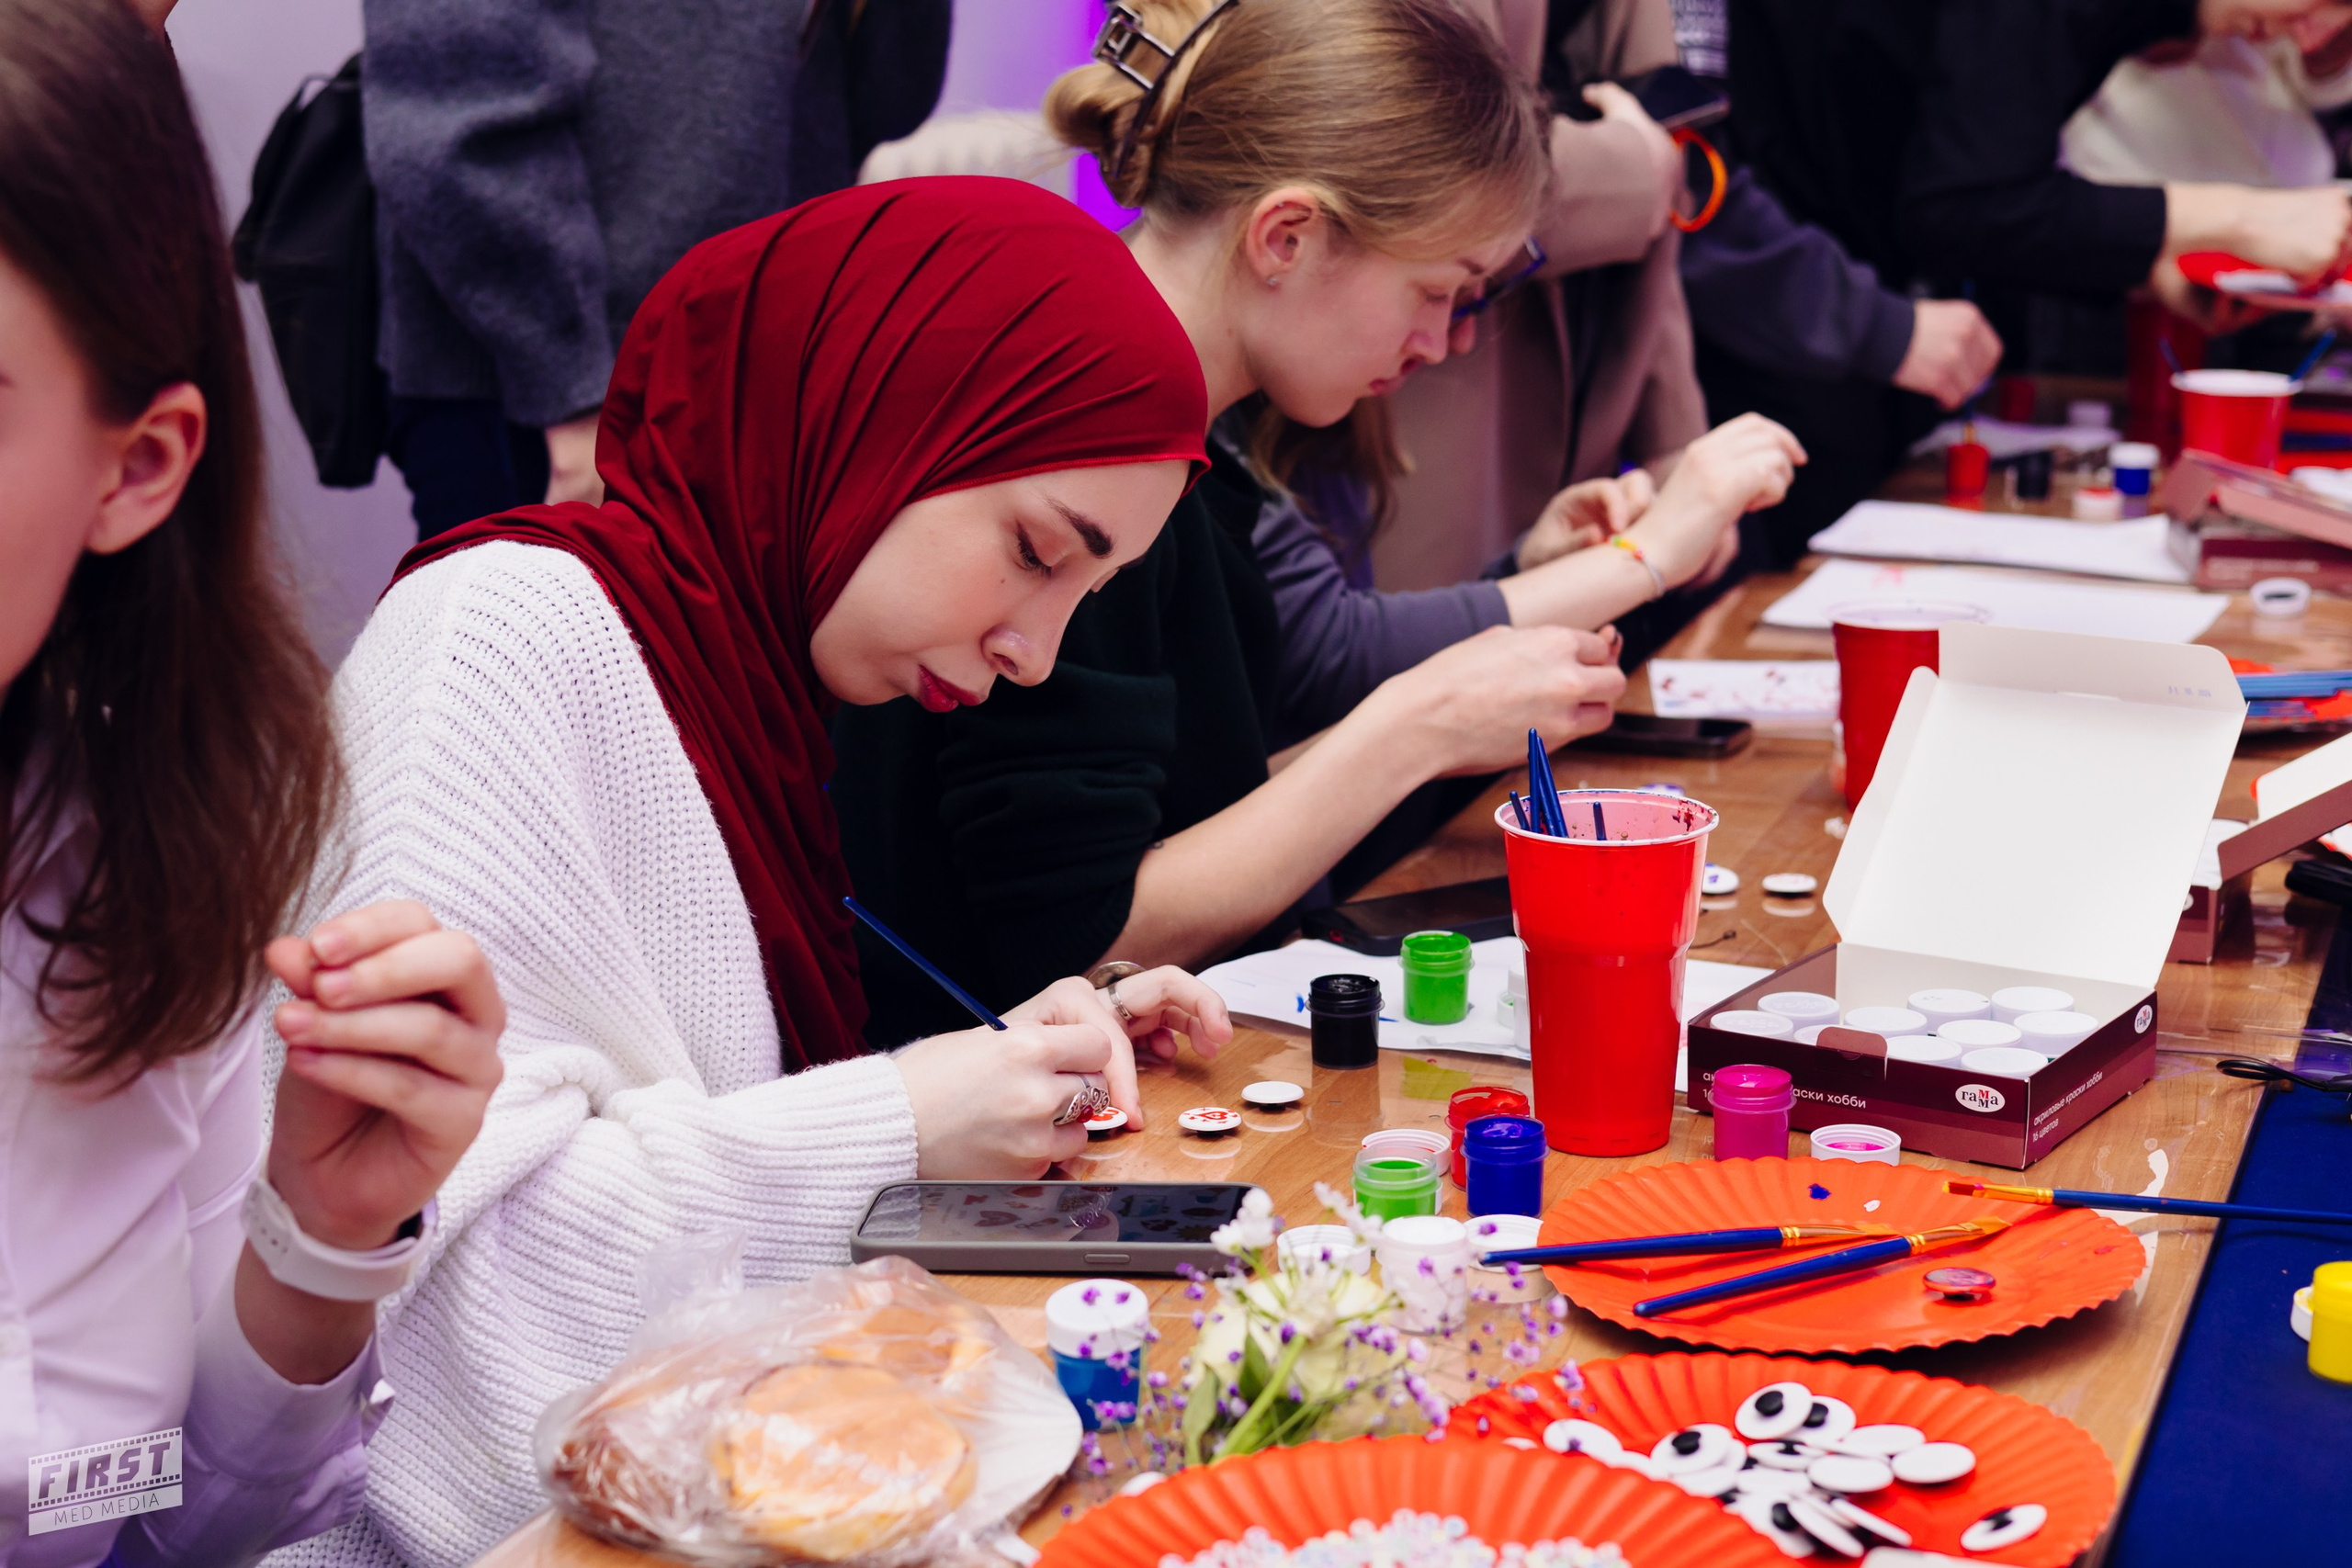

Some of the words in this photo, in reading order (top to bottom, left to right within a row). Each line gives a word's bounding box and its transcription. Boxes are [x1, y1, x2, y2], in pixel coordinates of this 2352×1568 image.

[1826, 1094, 1867, 1109] хобби
[2033, 1098, 2065, 1126] акриловые
[2065, 1083, 2086, 1105] краски
[2086, 1071, 2103, 1089] хобби
[2032, 1131, 2039, 1143] 16
[2039, 1118, 2059, 1139] цветов
